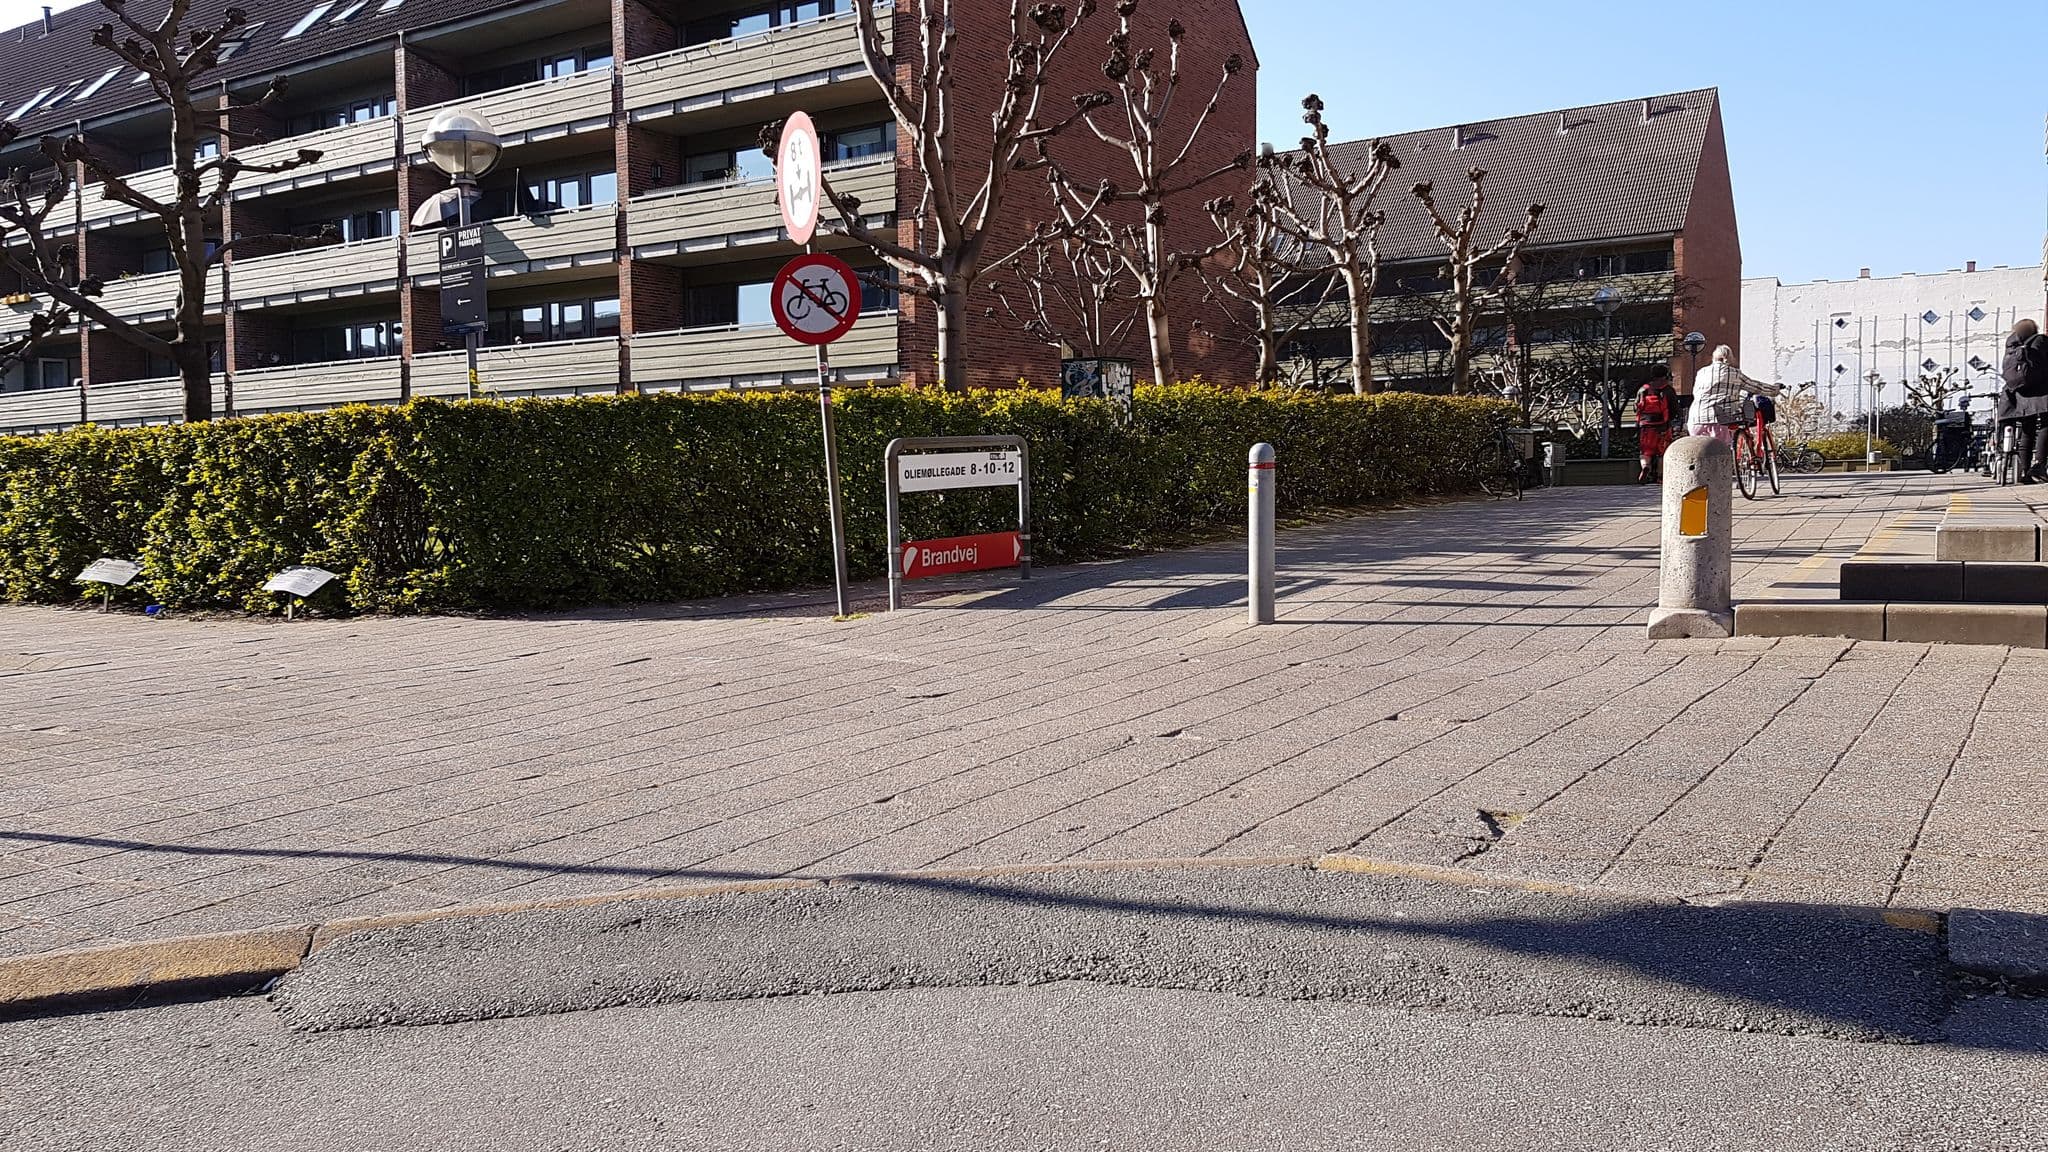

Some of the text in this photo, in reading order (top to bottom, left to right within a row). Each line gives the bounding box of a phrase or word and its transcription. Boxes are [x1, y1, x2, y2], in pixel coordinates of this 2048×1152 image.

[790, 142, 796, 162] 8
[458, 227, 481, 240] PRIVAT
[442, 237, 452, 257] P
[904, 466, 966, 479] OLIEMØLLEGADE
[921, 543, 978, 567] Brandvej
